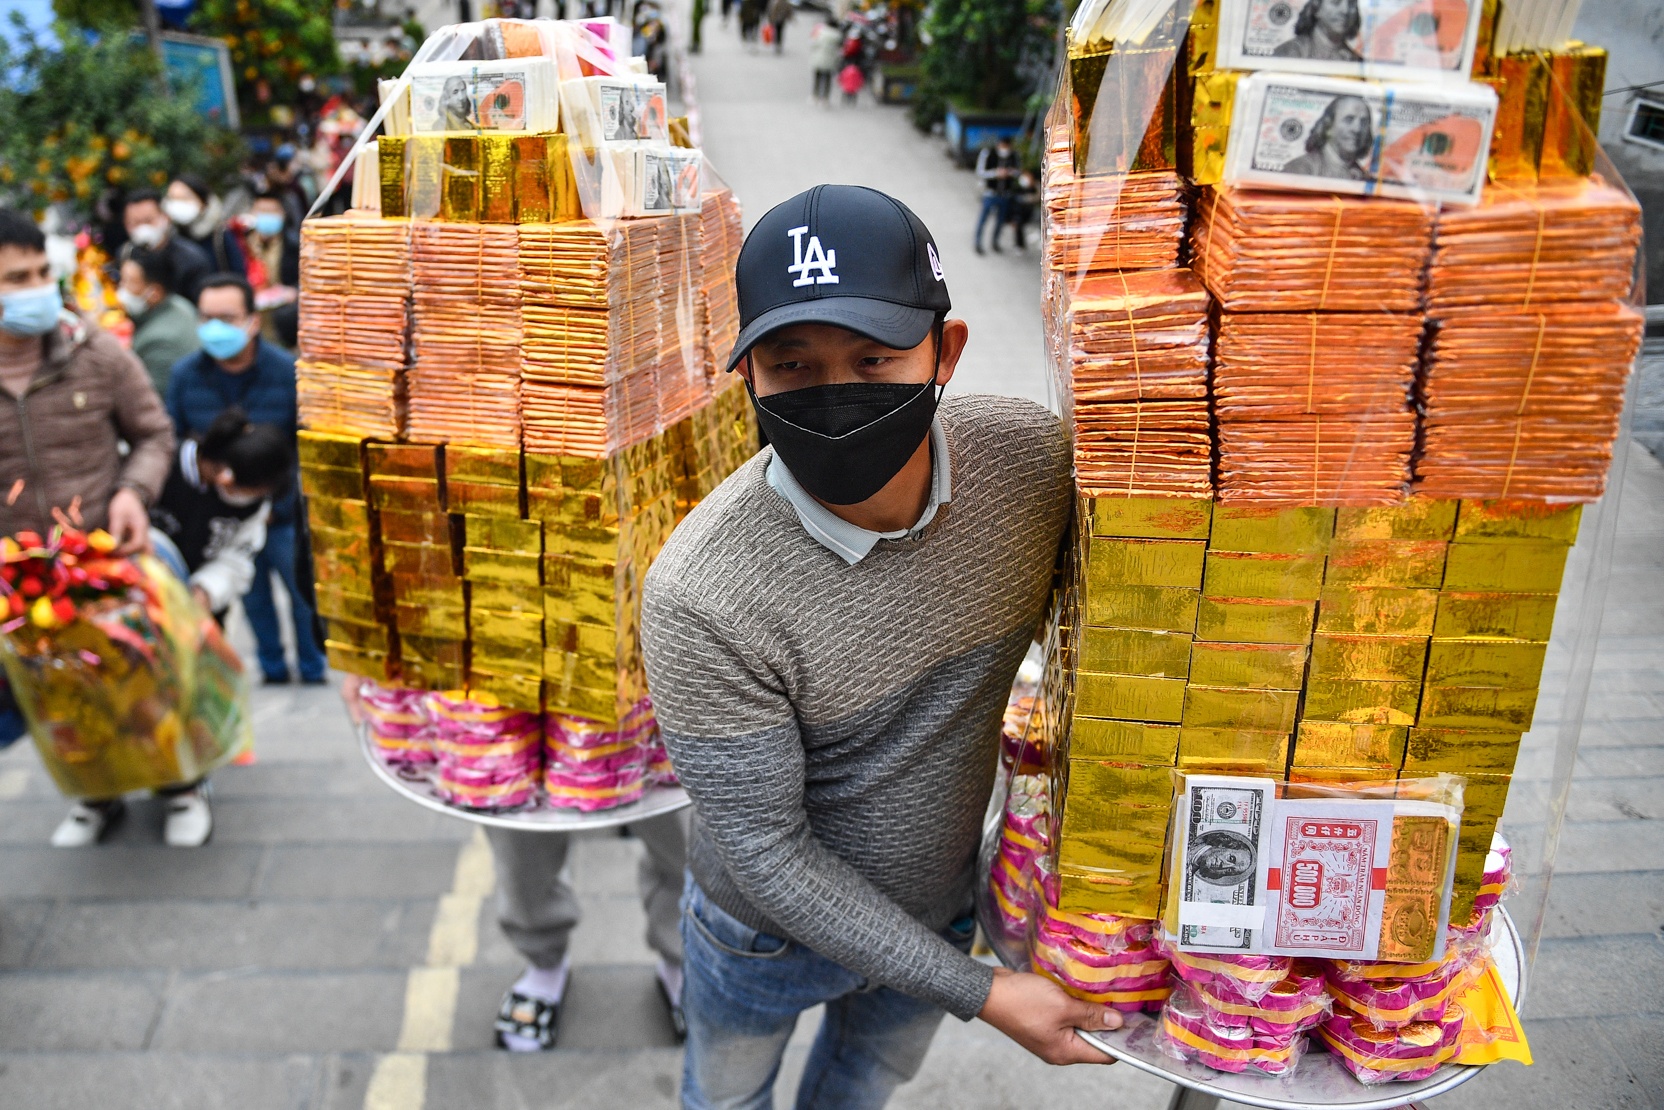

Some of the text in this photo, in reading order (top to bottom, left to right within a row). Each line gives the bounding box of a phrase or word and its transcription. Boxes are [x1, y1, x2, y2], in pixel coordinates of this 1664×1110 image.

[787, 225, 839, 288] LA
[1192, 792, 1203, 824] 100
[1292, 862, 1319, 906] 500.000
